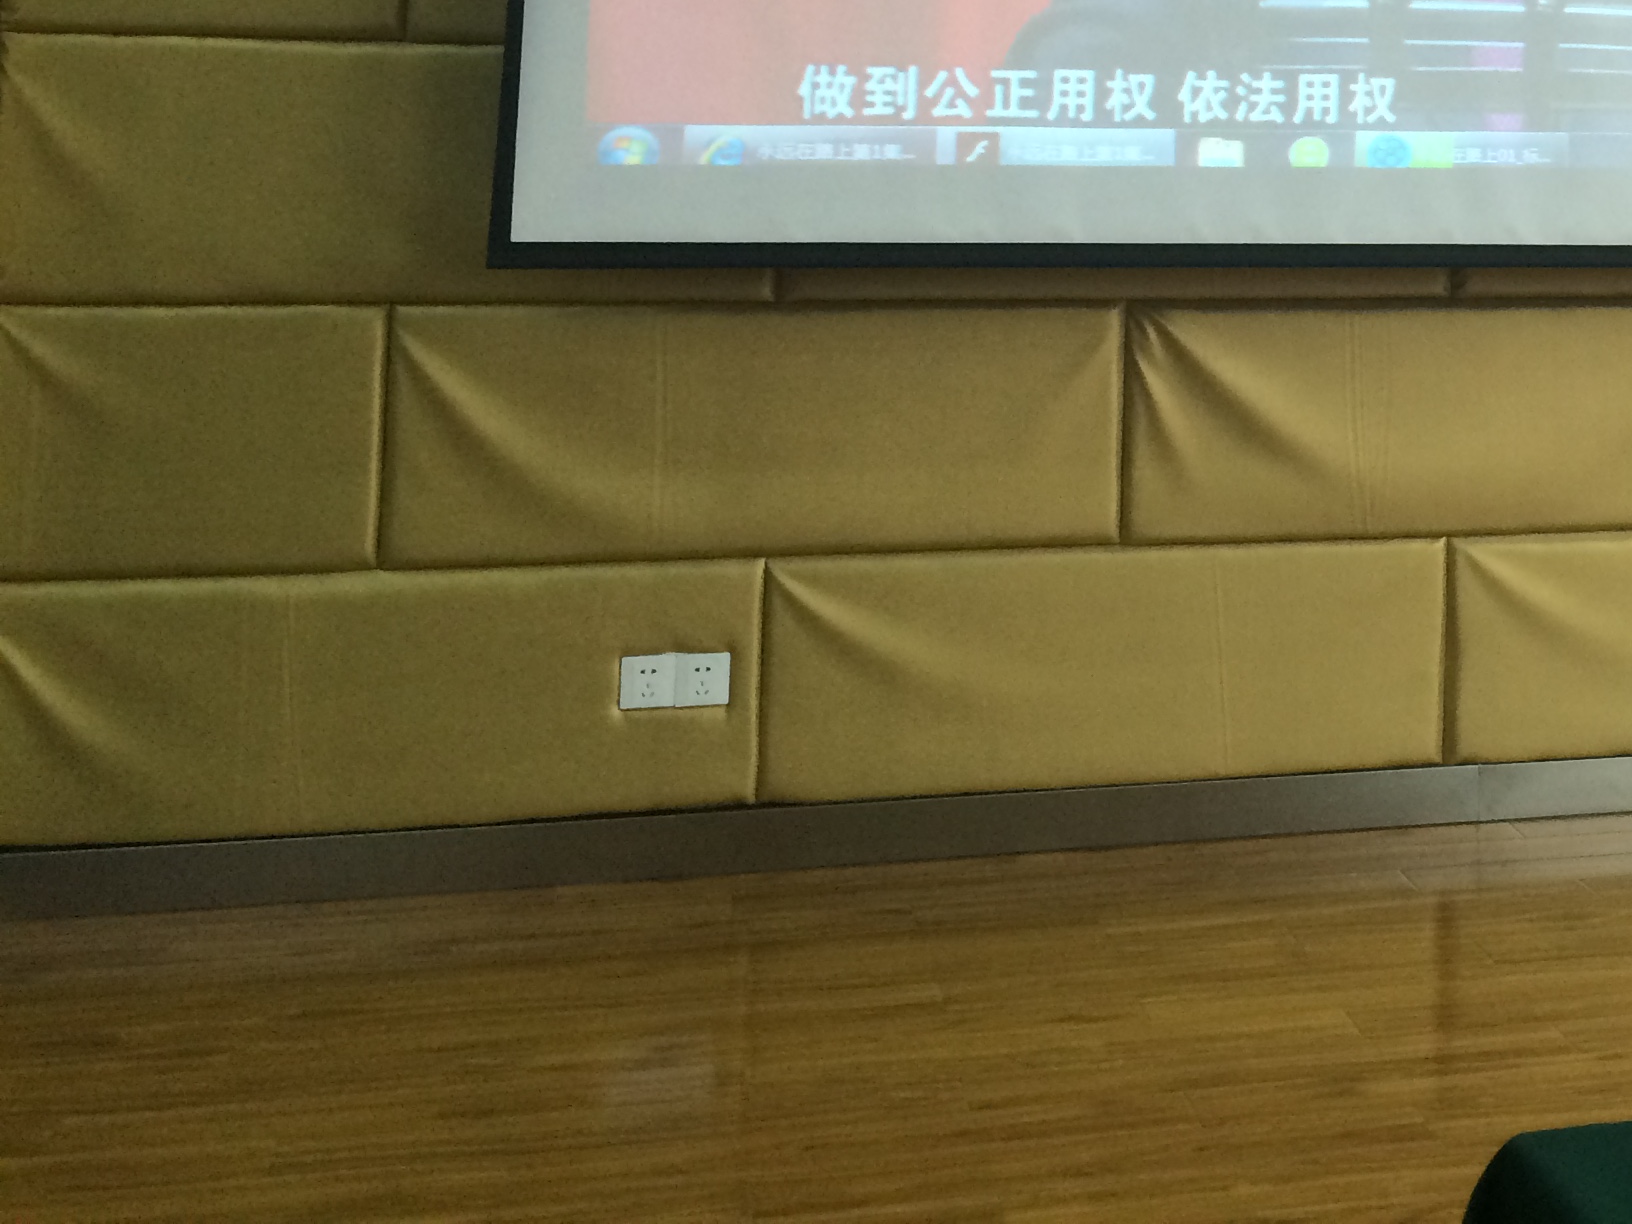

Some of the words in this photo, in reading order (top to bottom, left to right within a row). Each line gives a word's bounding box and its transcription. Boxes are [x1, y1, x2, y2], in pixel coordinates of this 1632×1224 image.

[798, 64, 1157, 122] 做到公正用权
[1177, 70, 1397, 124] 依法用权
